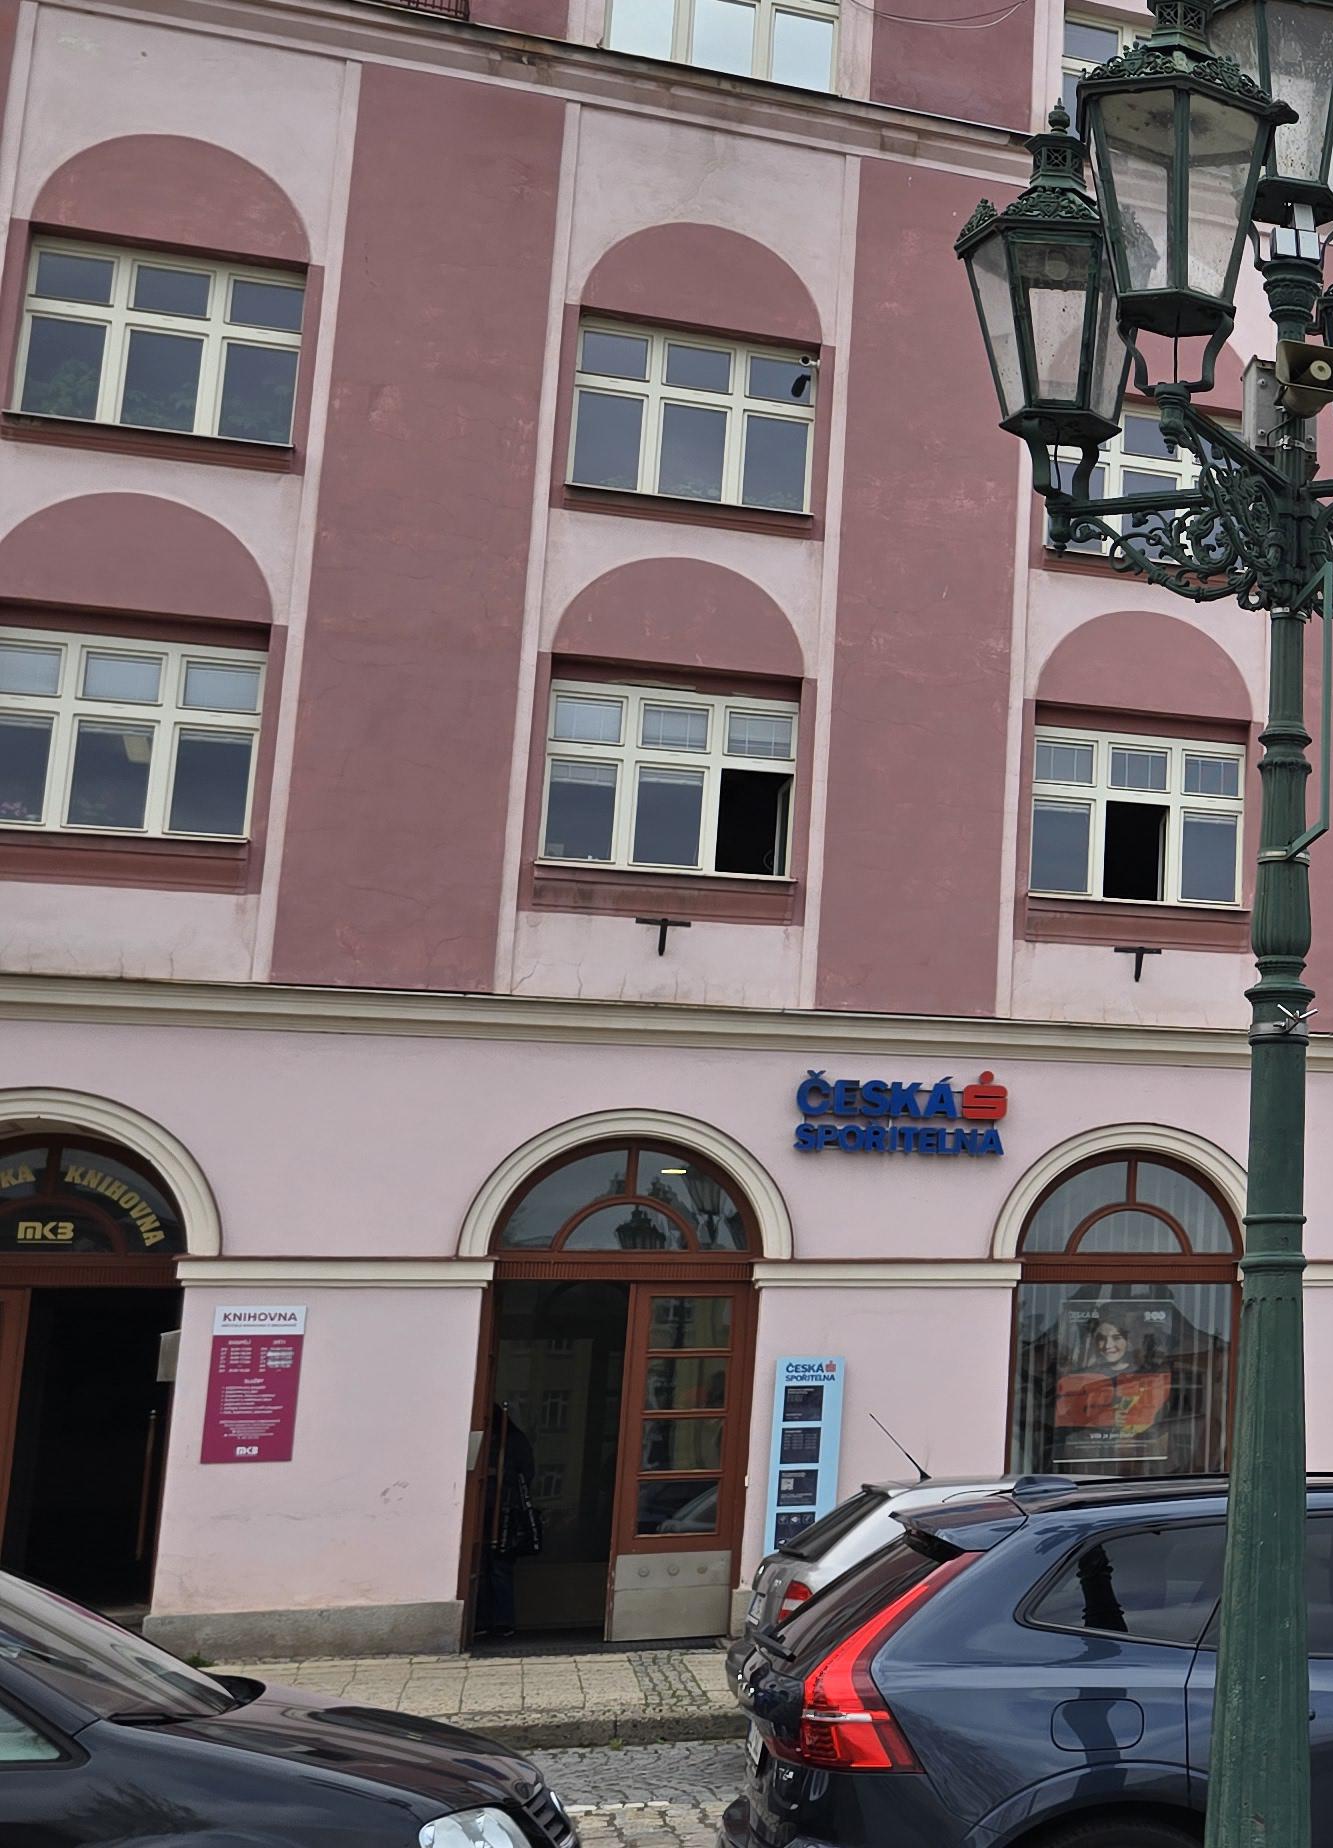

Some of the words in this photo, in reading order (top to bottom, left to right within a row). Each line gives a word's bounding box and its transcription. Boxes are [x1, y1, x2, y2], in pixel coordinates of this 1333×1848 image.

[796, 1069, 958, 1119] ČESKÁ
[793, 1121, 1004, 1155] SPOŘITELNA
[64, 1165, 166, 1247] KNIHOVNA
[223, 1312, 298, 1322] KNIHOVNA
[786, 1362, 825, 1373] ČESKÁ
